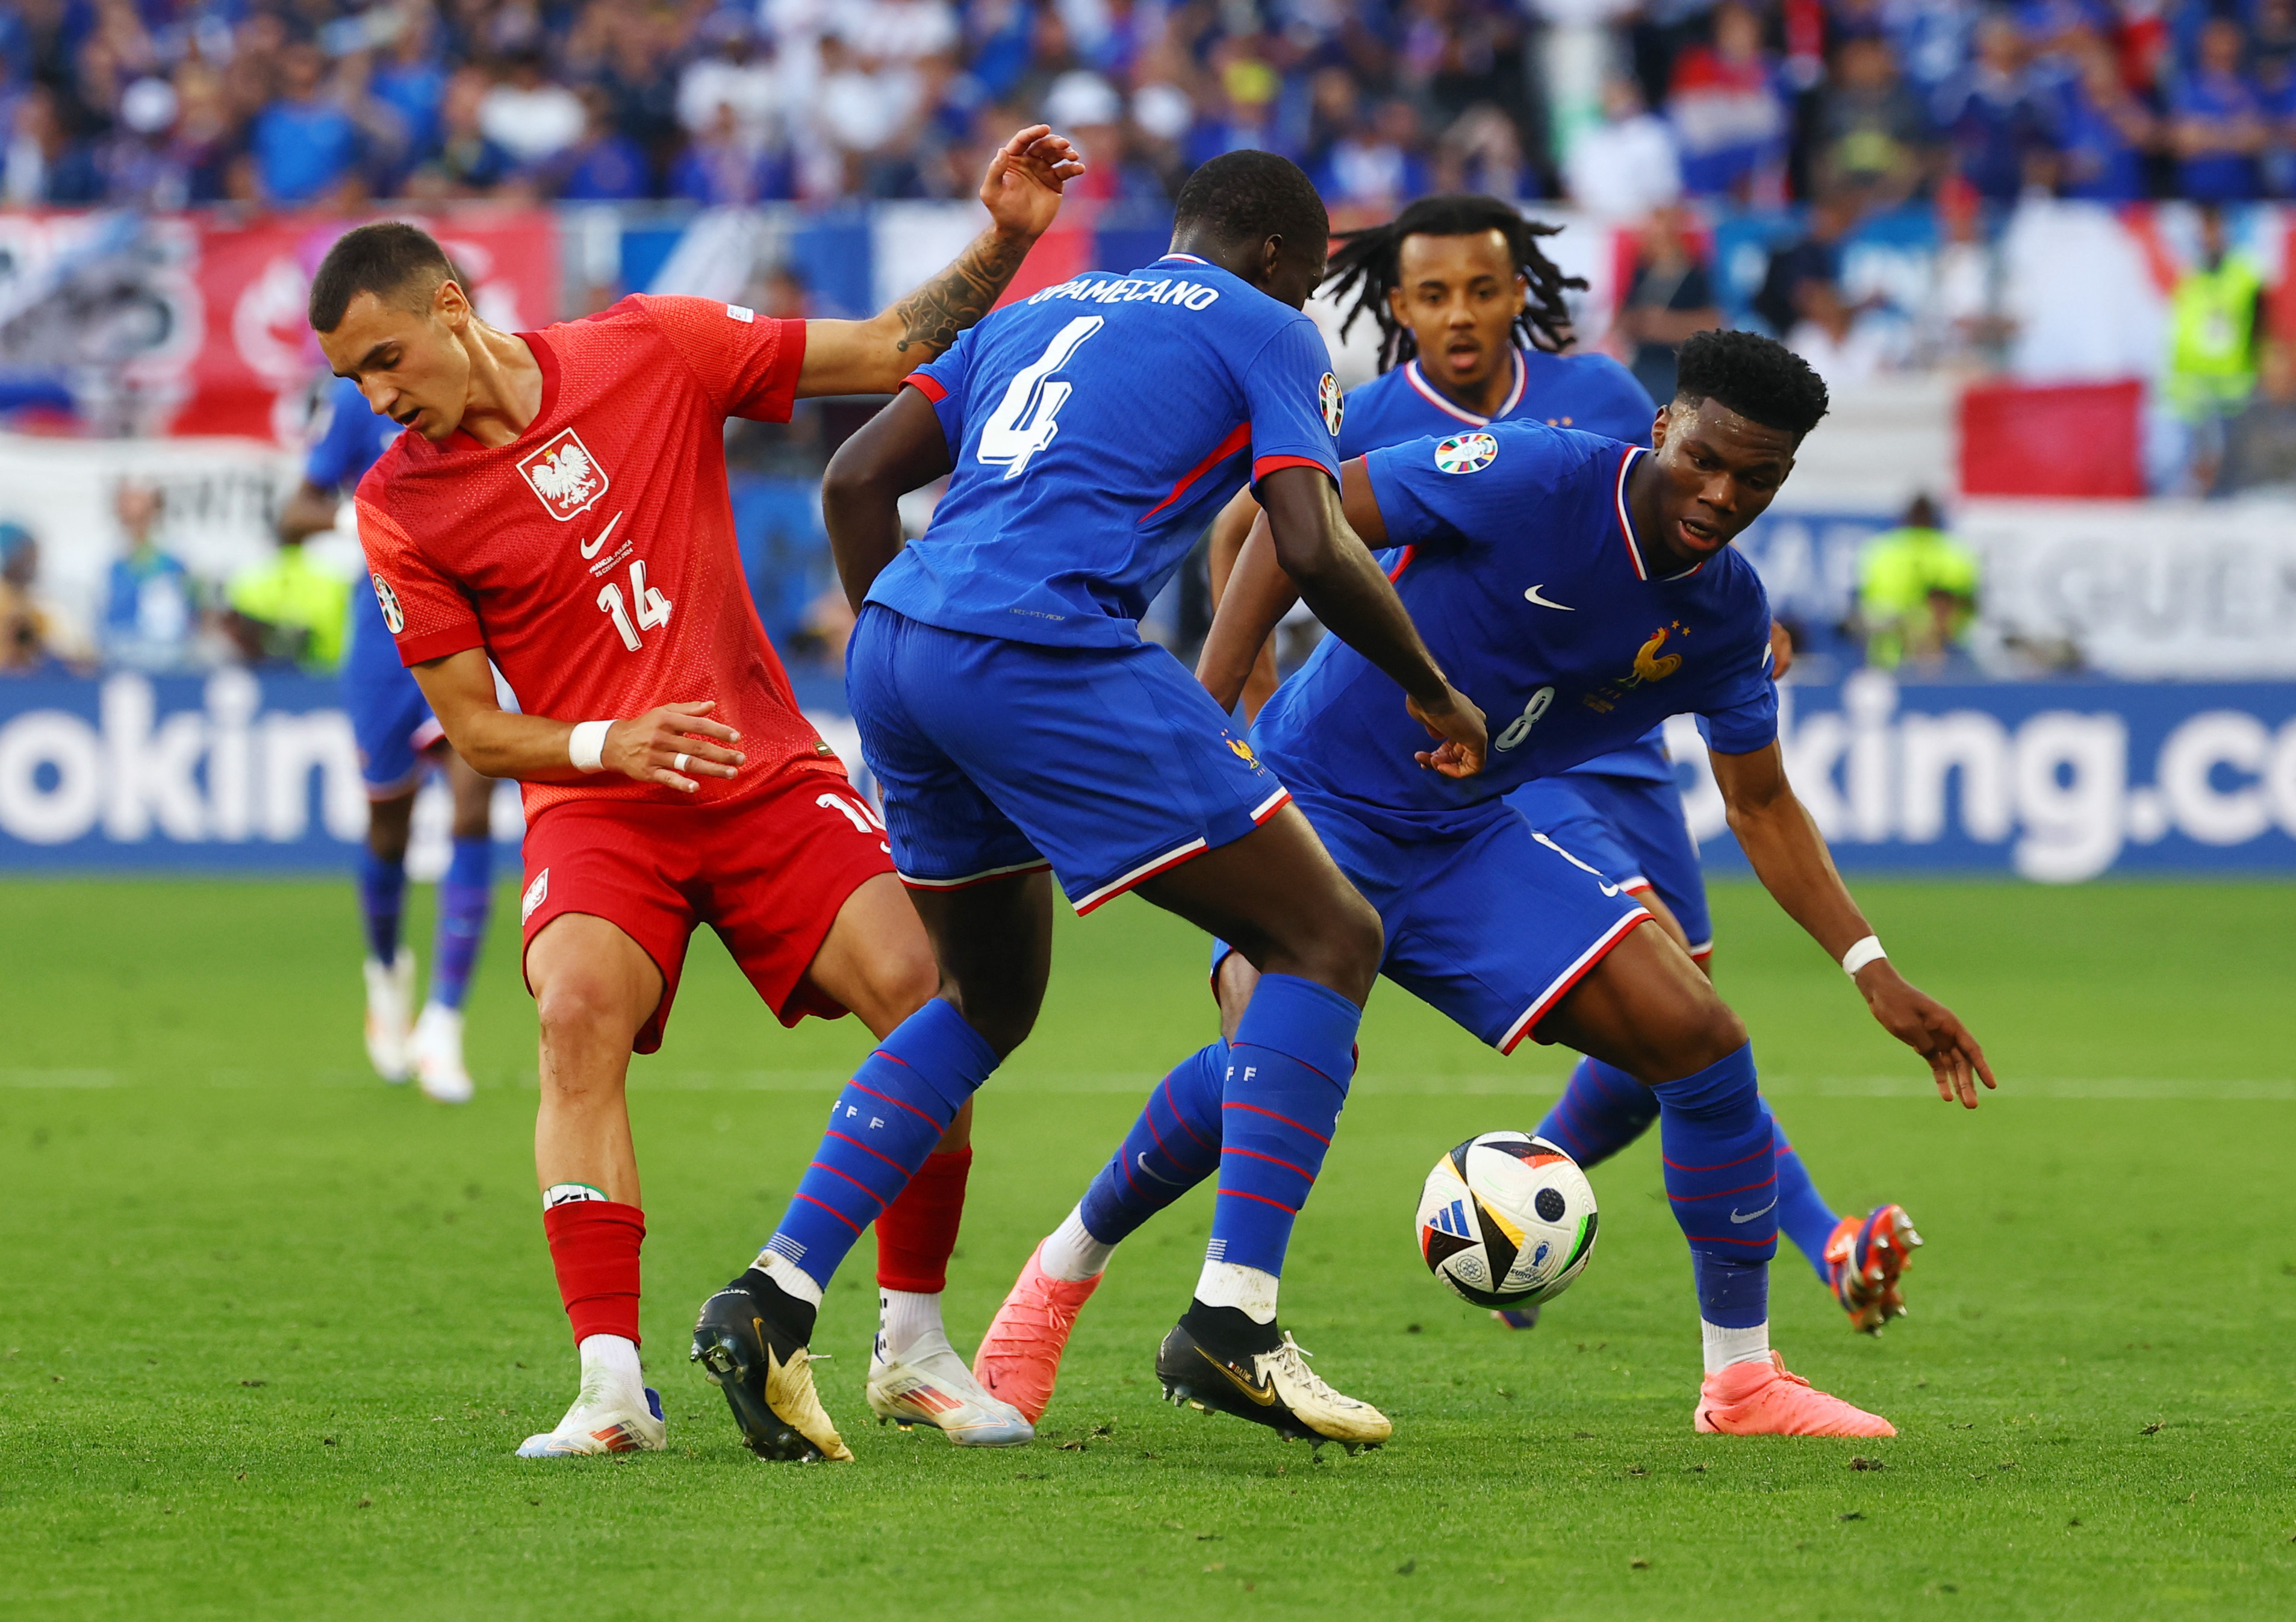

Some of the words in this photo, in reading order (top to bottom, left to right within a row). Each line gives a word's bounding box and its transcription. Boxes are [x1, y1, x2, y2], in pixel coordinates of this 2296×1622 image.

[1027, 278, 1219, 311] UPAMECANO
[976, 315, 1105, 481] 4
[596, 559, 672, 652] 14
[0, 669, 456, 883] okin
[1495, 686, 1555, 752] 8
[1663, 667, 2296, 884] oking.c
